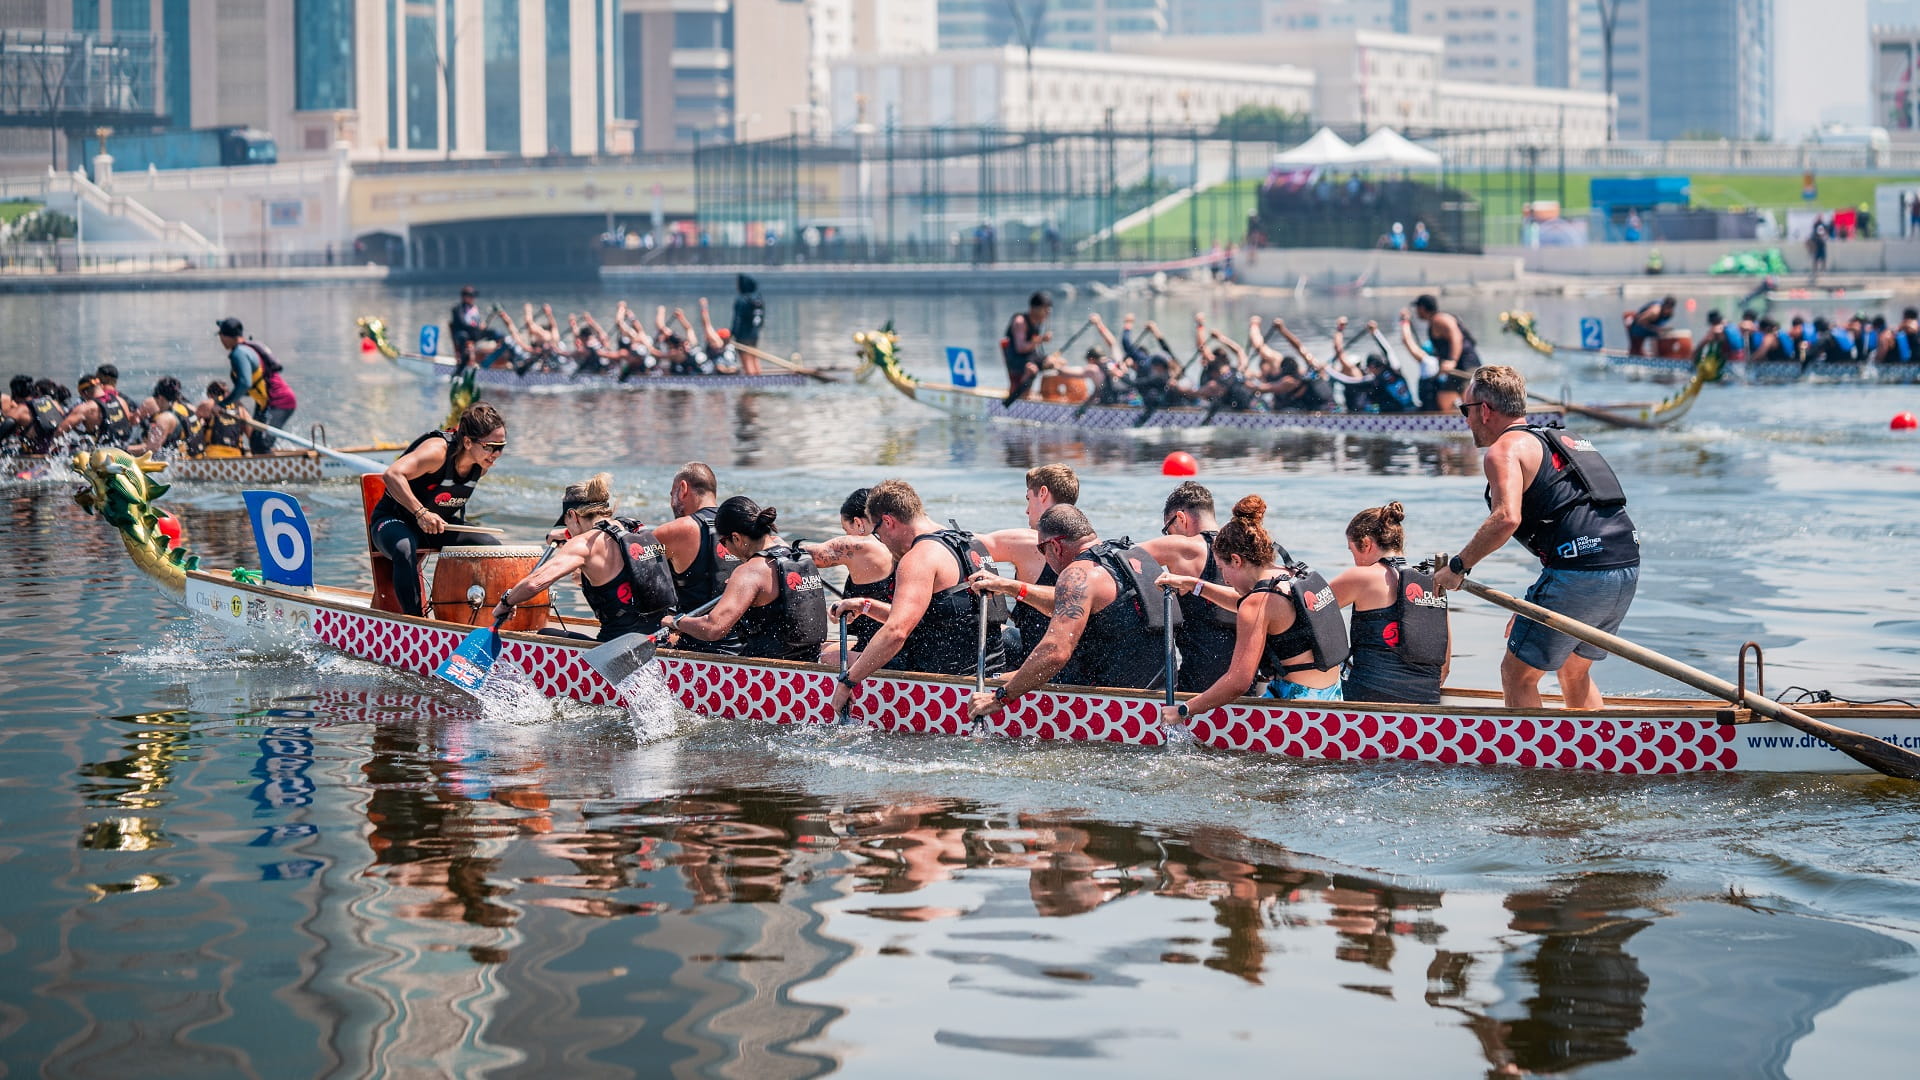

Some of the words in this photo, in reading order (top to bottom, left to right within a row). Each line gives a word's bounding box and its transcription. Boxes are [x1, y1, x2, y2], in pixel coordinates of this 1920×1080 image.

[422, 326, 436, 354] 3
[1585, 320, 1600, 346] 2
[953, 351, 976, 383] 4
[261, 497, 306, 571] 6
